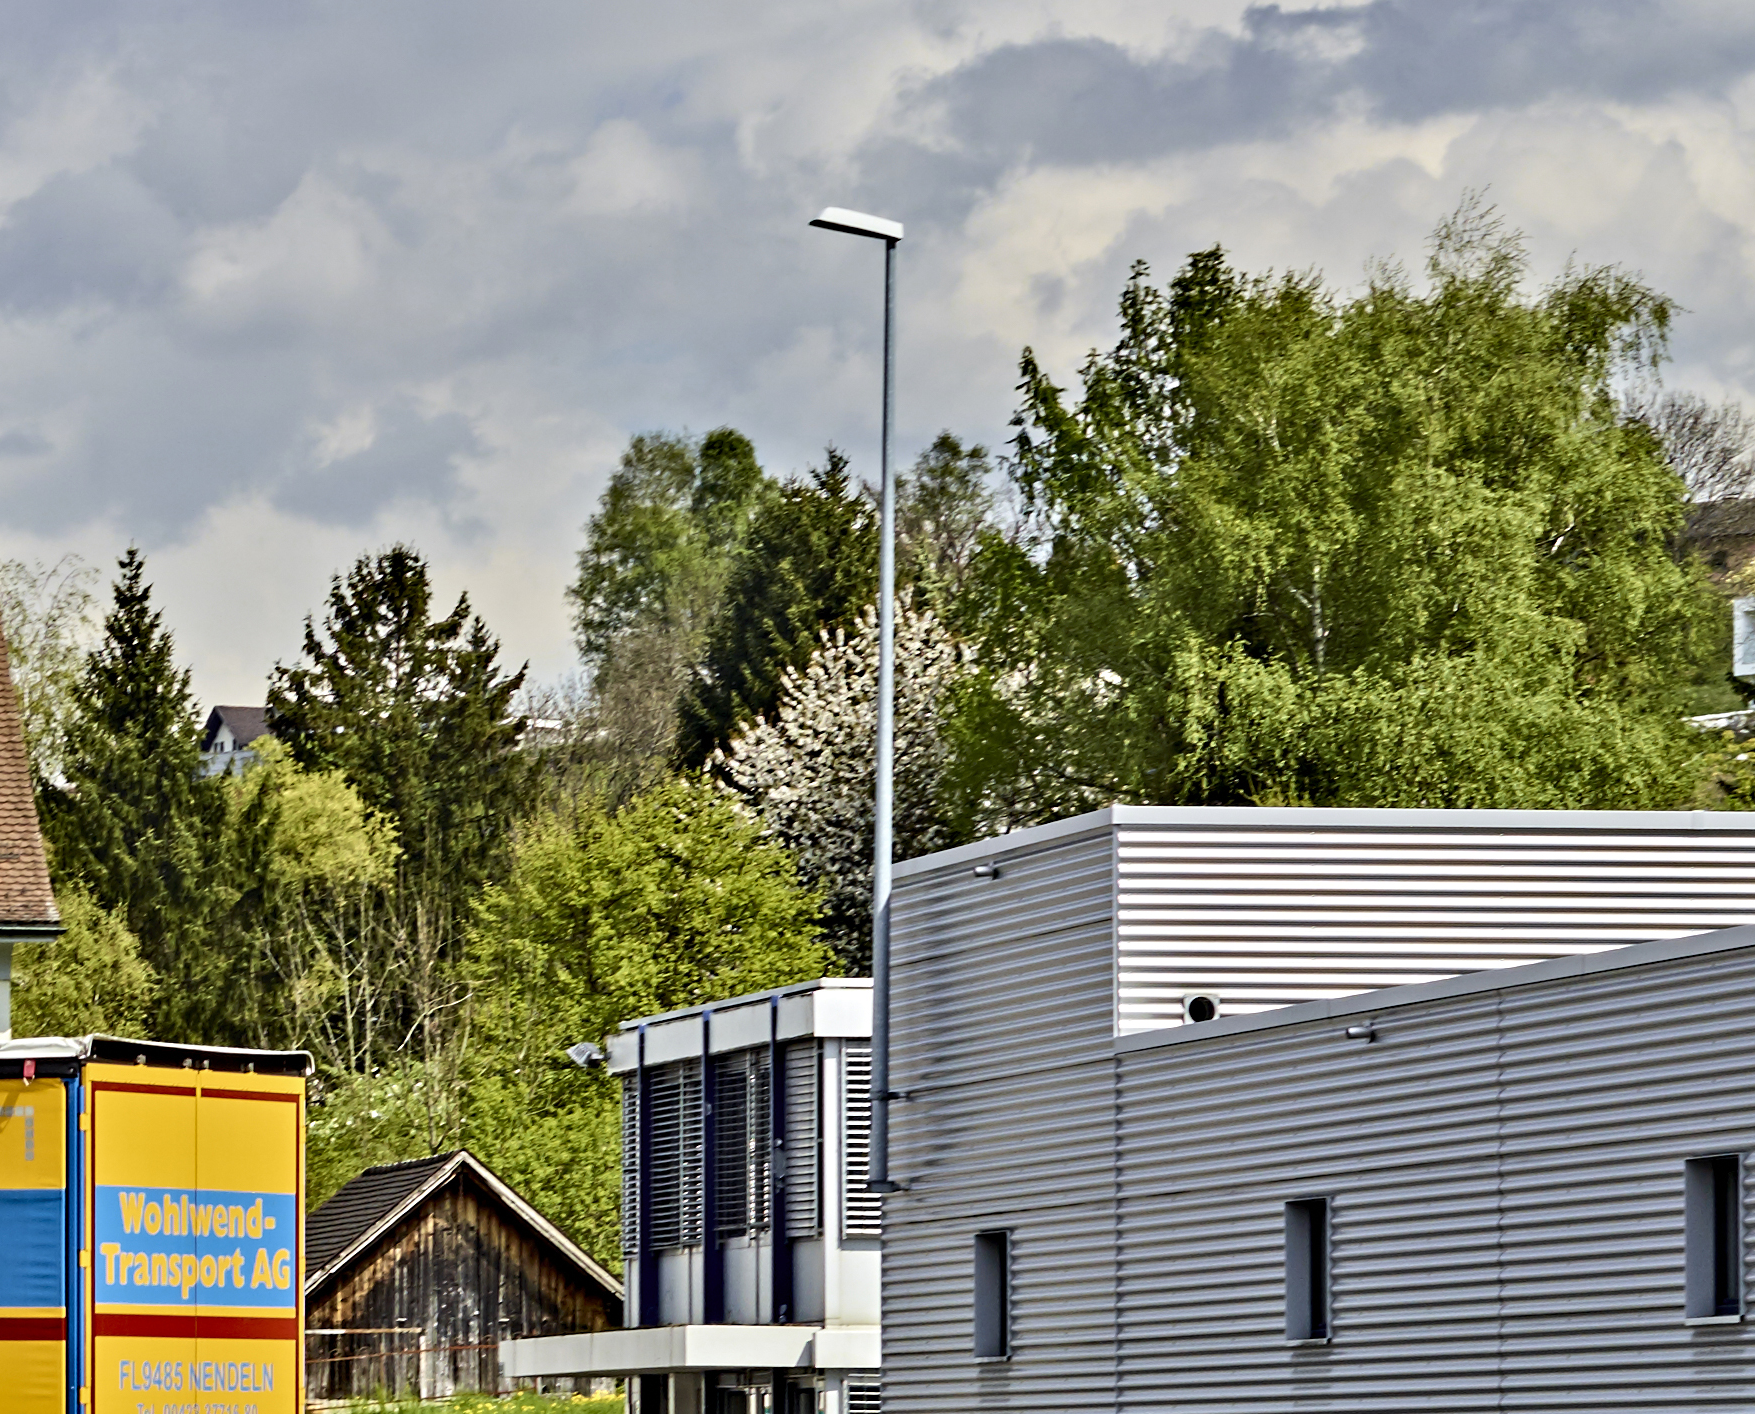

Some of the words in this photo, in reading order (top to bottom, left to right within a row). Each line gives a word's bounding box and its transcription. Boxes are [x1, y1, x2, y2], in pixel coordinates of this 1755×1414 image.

[119, 1192, 276, 1238] Wohlwend-
[100, 1242, 245, 1299] Transport
[251, 1248, 291, 1290] AG
[188, 1362, 274, 1392] NENDELN
